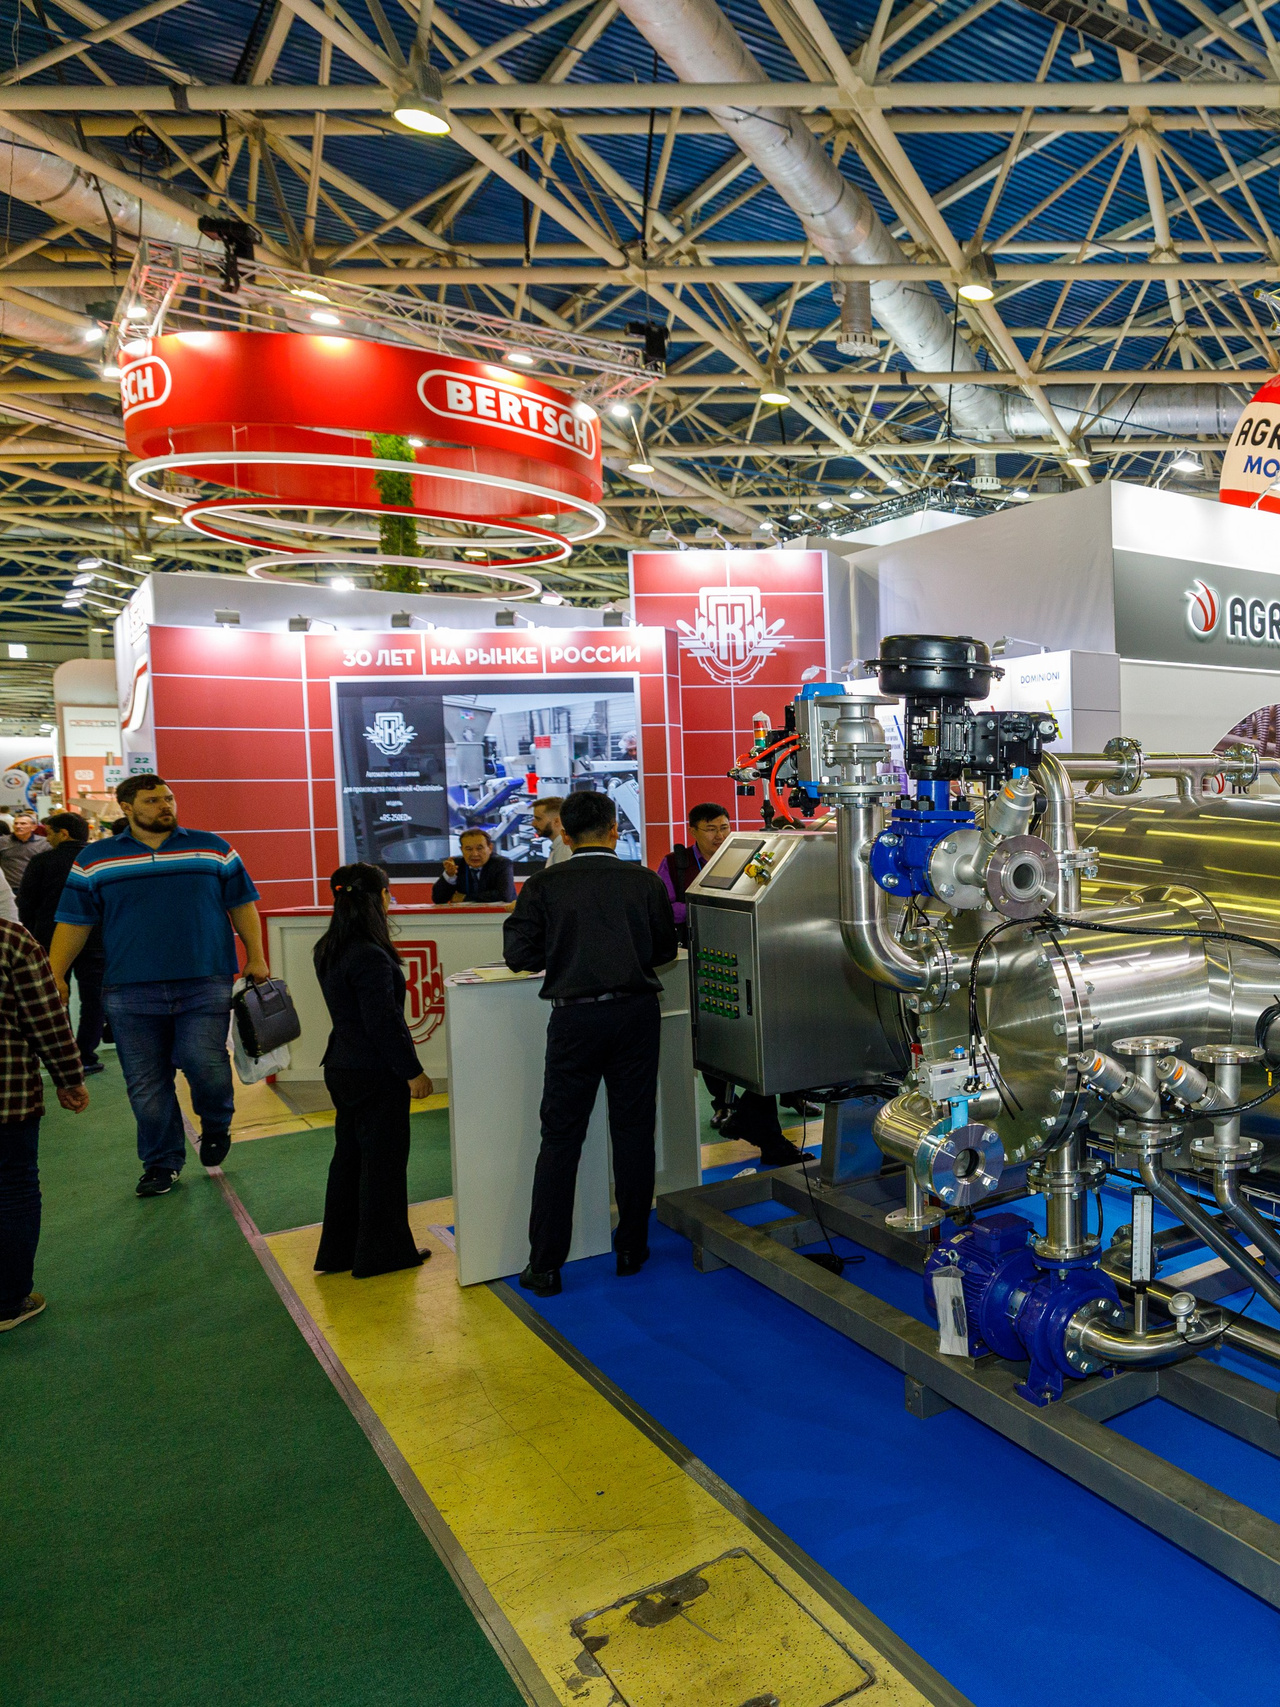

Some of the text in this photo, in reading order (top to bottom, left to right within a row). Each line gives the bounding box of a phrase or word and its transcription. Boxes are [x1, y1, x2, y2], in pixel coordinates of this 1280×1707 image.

[446, 379, 589, 451] BERTSCH
[342, 644, 642, 667] 30 ЛЕТ НА РЫНКЕ РОССИИ
